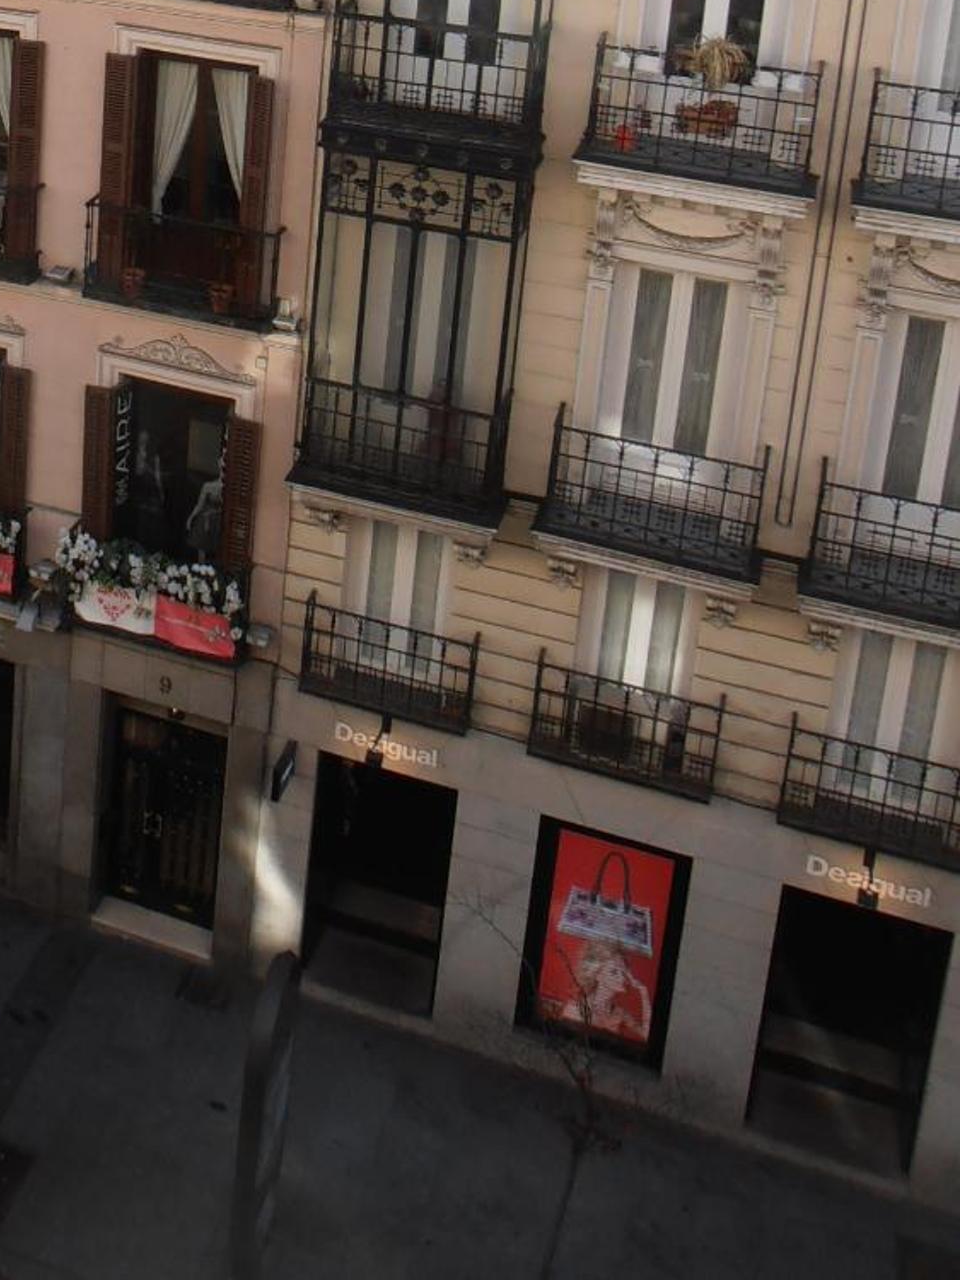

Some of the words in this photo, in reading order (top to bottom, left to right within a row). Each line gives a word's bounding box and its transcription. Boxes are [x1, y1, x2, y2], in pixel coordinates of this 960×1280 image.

[159, 675, 173, 695] 9
[335, 721, 439, 768] Desigual
[806, 855, 932, 907] Desigual
